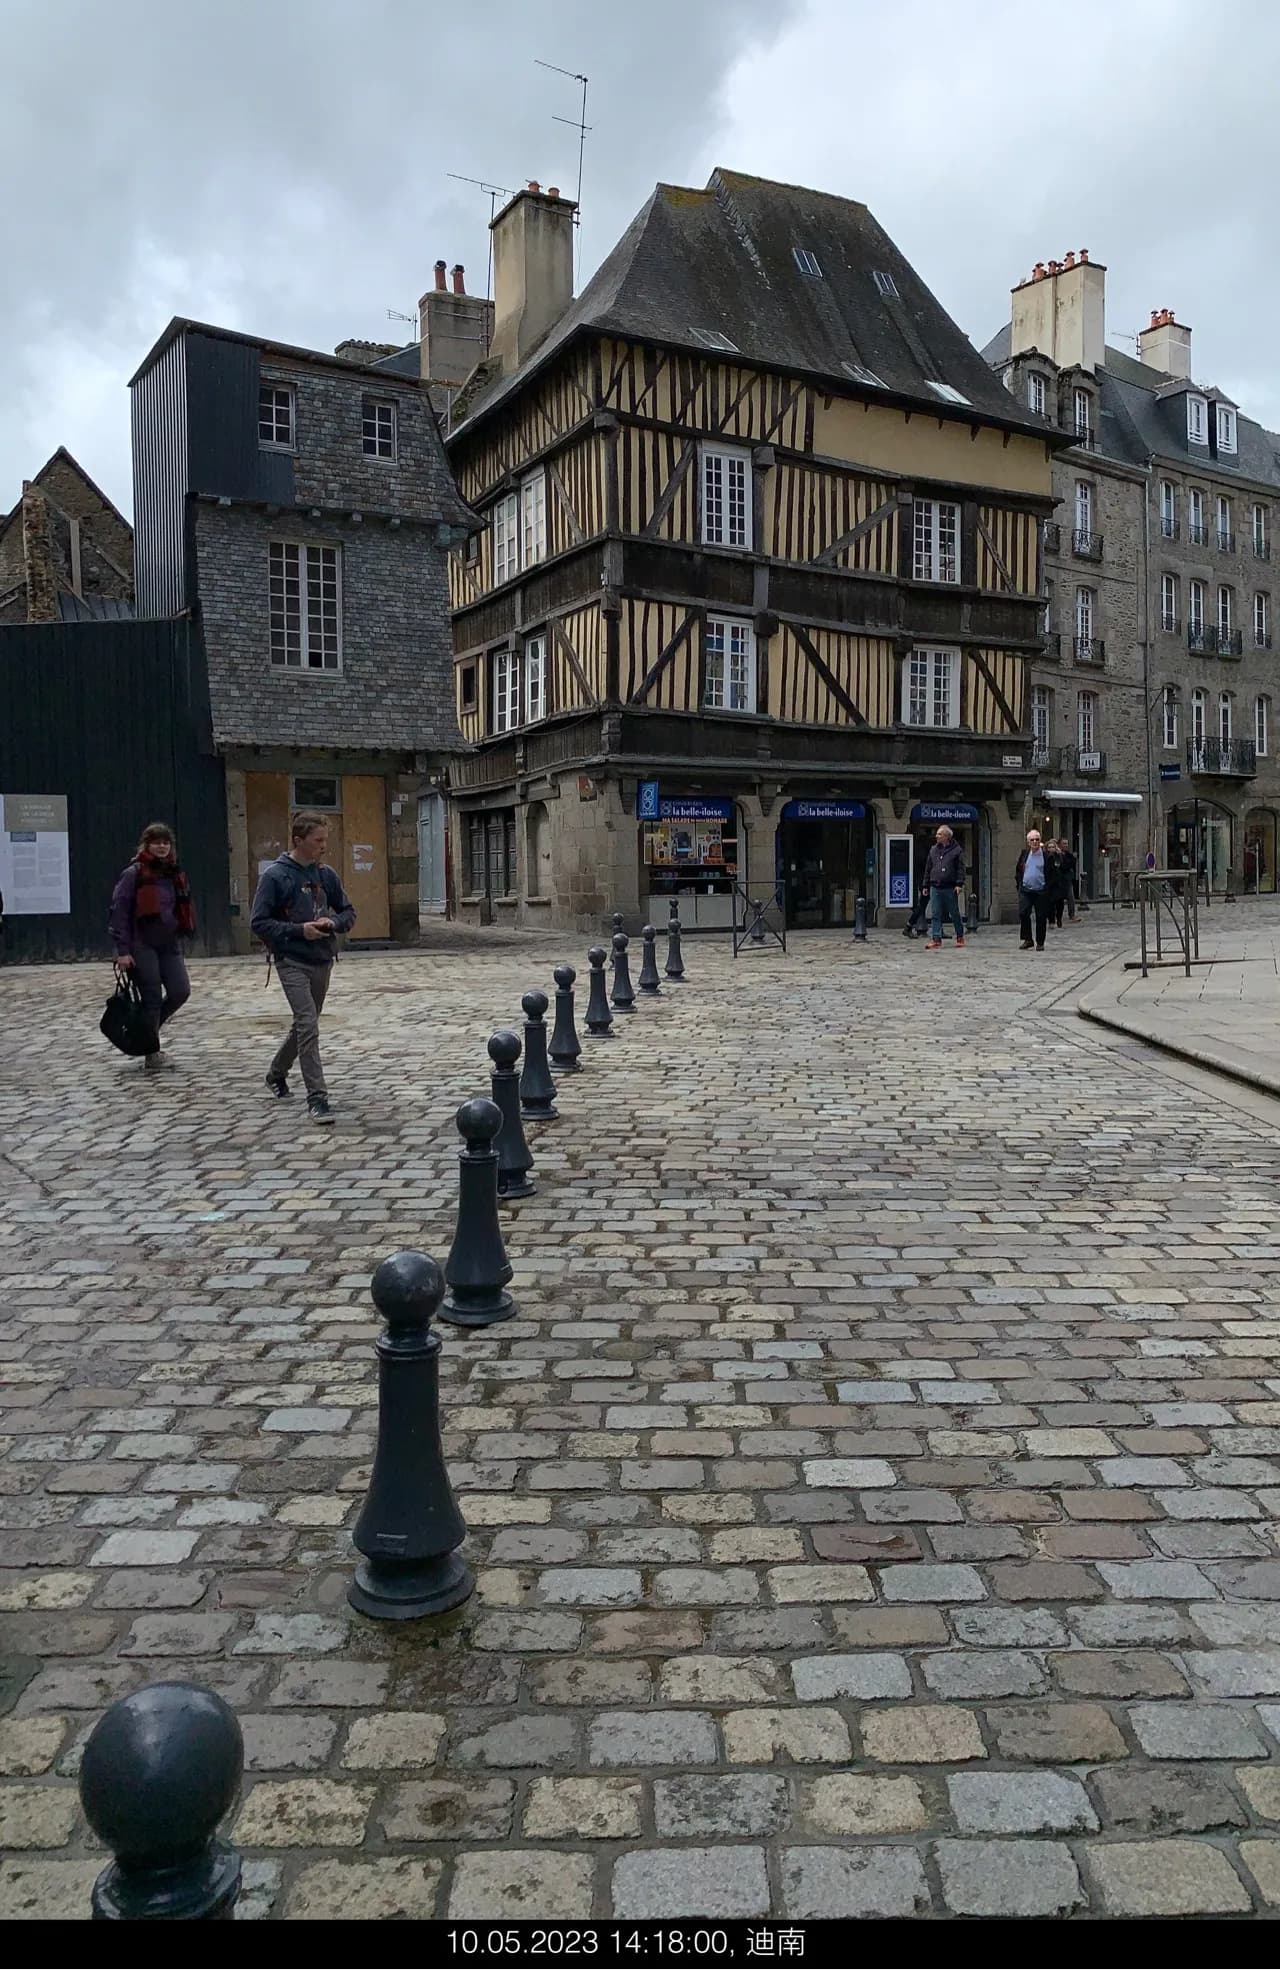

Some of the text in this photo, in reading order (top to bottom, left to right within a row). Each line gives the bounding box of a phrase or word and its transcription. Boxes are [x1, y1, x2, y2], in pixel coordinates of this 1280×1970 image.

[672, 806, 722, 817] la belle-iloise
[809, 807, 854, 817] la belle-iloise
